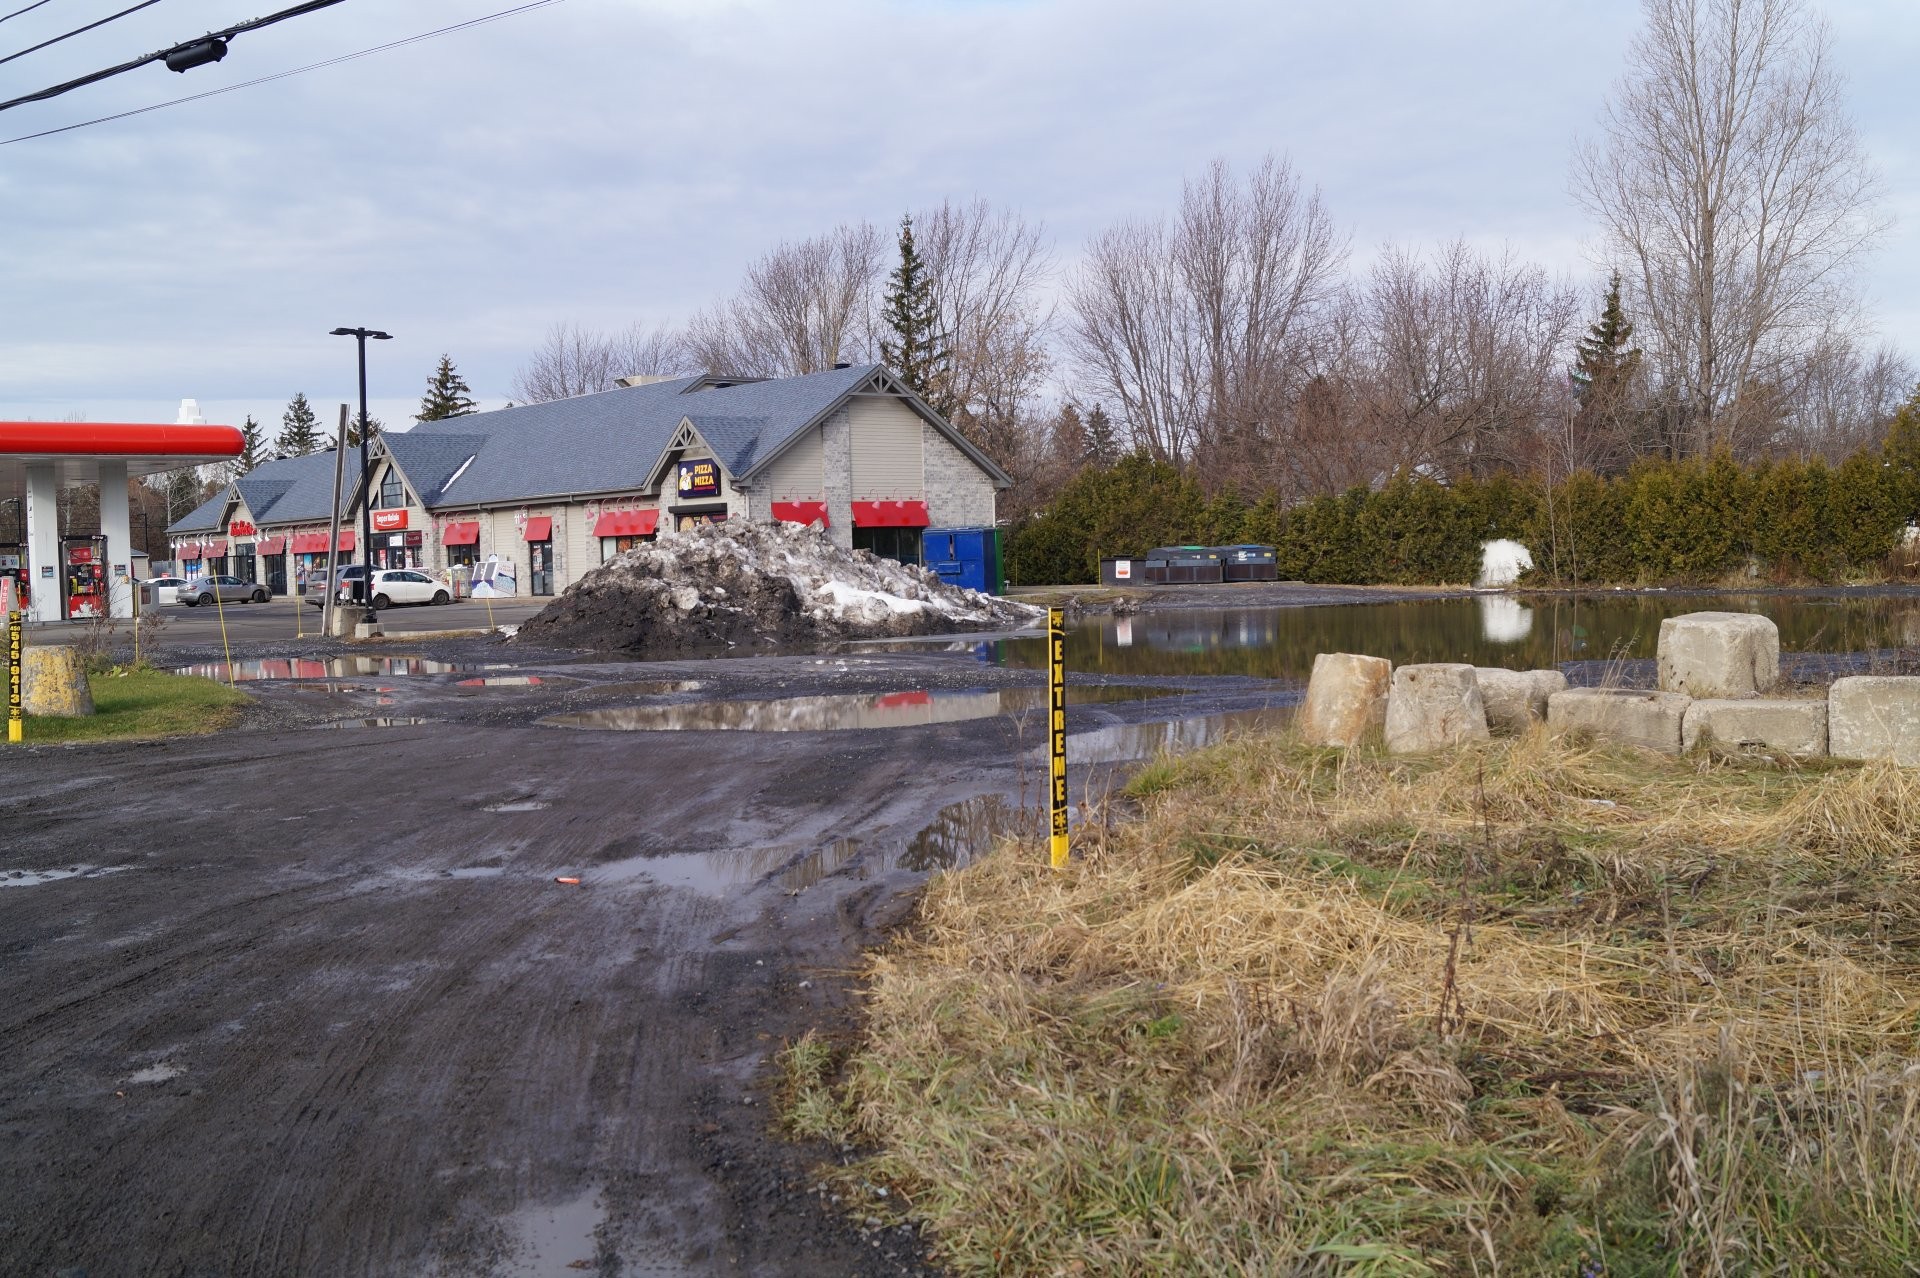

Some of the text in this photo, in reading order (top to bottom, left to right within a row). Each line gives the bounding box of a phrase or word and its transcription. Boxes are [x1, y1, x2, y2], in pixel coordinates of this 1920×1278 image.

[694, 464, 712, 474] PIZZA
[694, 476, 714, 486] MIZZA
[1053, 640, 1065, 801] EXTREME
